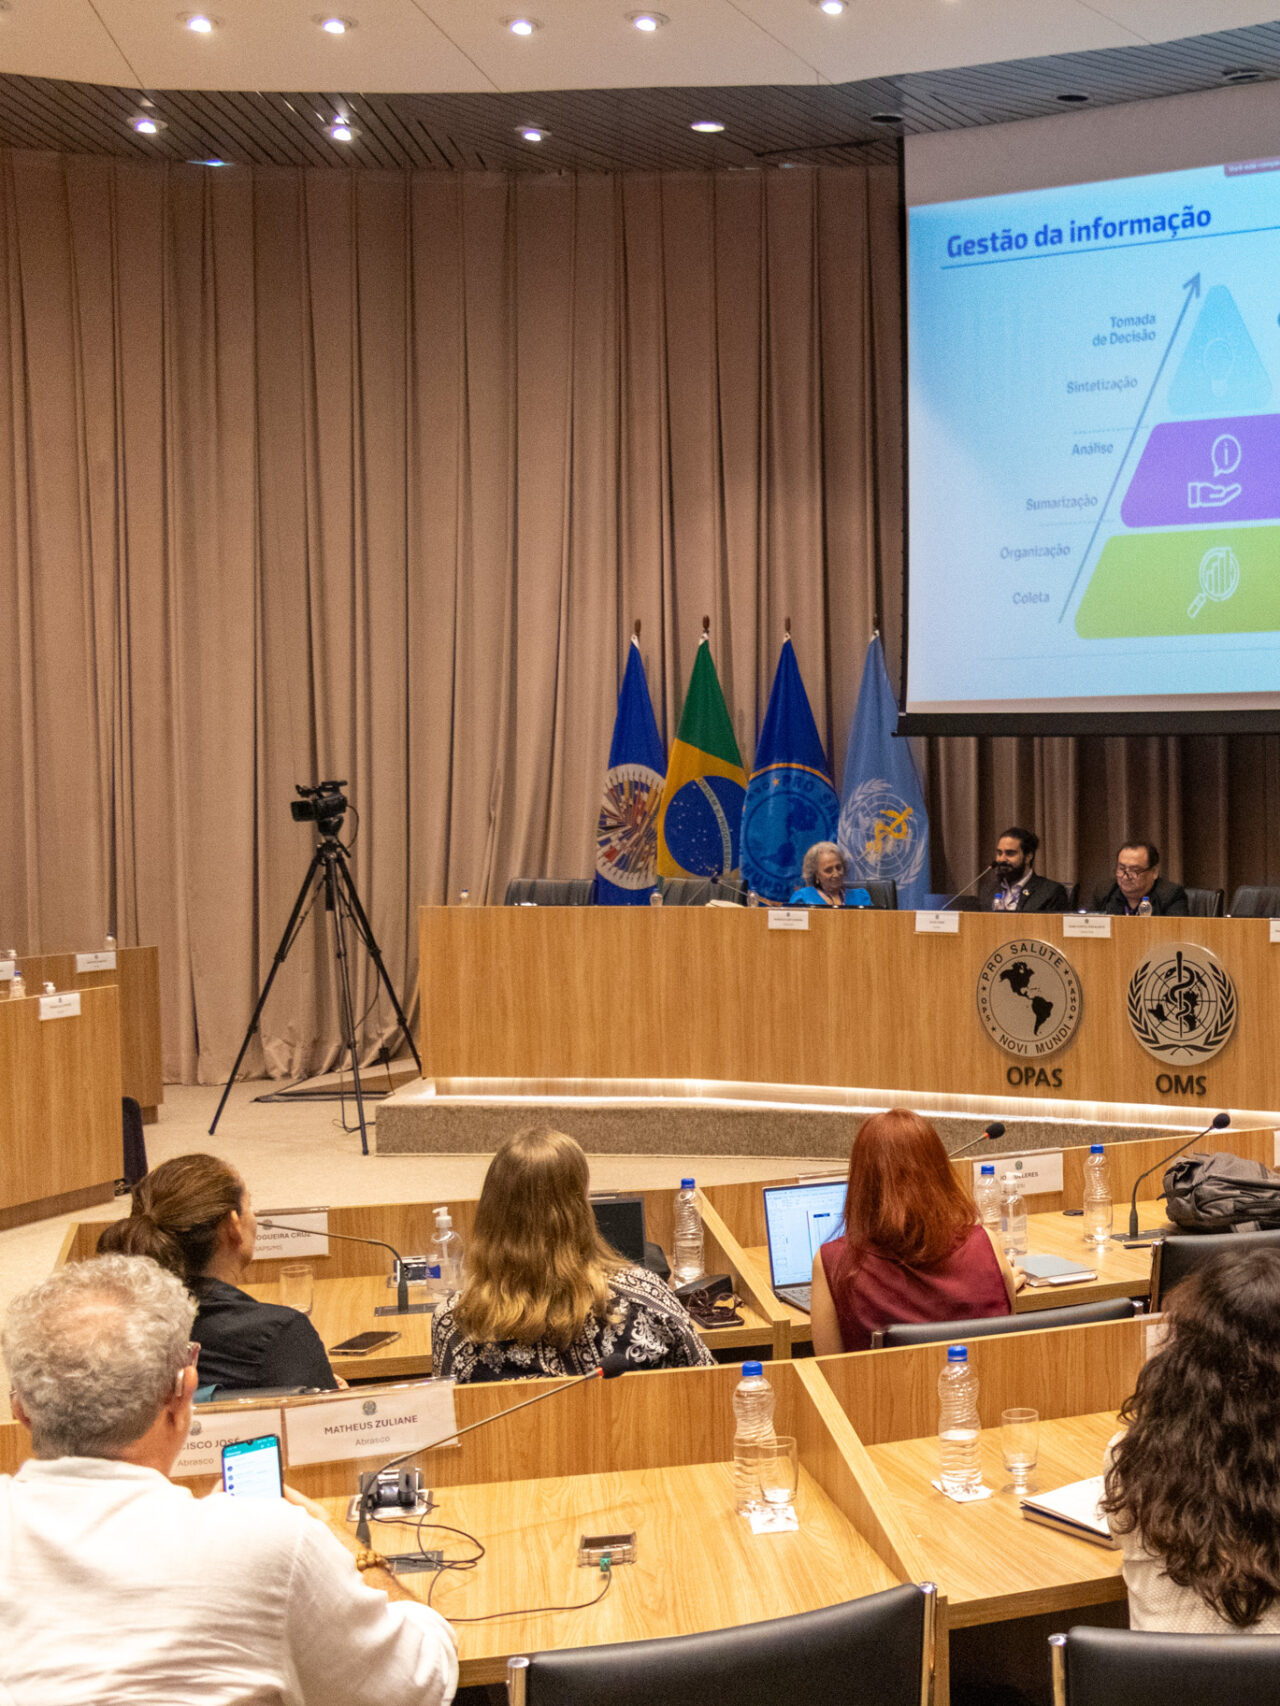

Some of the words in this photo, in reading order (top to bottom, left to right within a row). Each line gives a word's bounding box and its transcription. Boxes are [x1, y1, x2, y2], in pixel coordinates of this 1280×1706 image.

[947, 229, 1028, 258] Gestão
[1034, 224, 1063, 247] da
[1070, 204, 1211, 243] informação
[1110, 314, 1156, 328] Tomada
[1092, 334, 1107, 347] de
[1110, 331, 1156, 345] Decisão
[1066, 377, 1138, 394] Sintetização
[1072, 442, 1114, 455] Análise
[1026, 494, 1098, 511] Sumarização
[1000, 543, 1071, 561] Organização
[1012, 591, 1050, 604] Coleta
[982, 954, 1003, 982] PRO
[1010, 942, 1064, 968] SALUTE
[1068, 980, 1076, 1013] PAHO
[981, 997, 990, 1022] OPS
[999, 1034, 1028, 1054] NOVI
[1035, 1024, 1072, 1054] MUNDI
[1007, 1066, 1063, 1088] OPAS
[1155, 1074, 1207, 1096] OMS
[324, 1420, 373, 1435] MATHEUS
[375, 1414, 418, 1430] ZULIANE
[184, 1440, 212, 1450] ISCO
[355, 1435, 390, 1447] Abrasco
[177, 1458, 214, 1467] Abrasco
